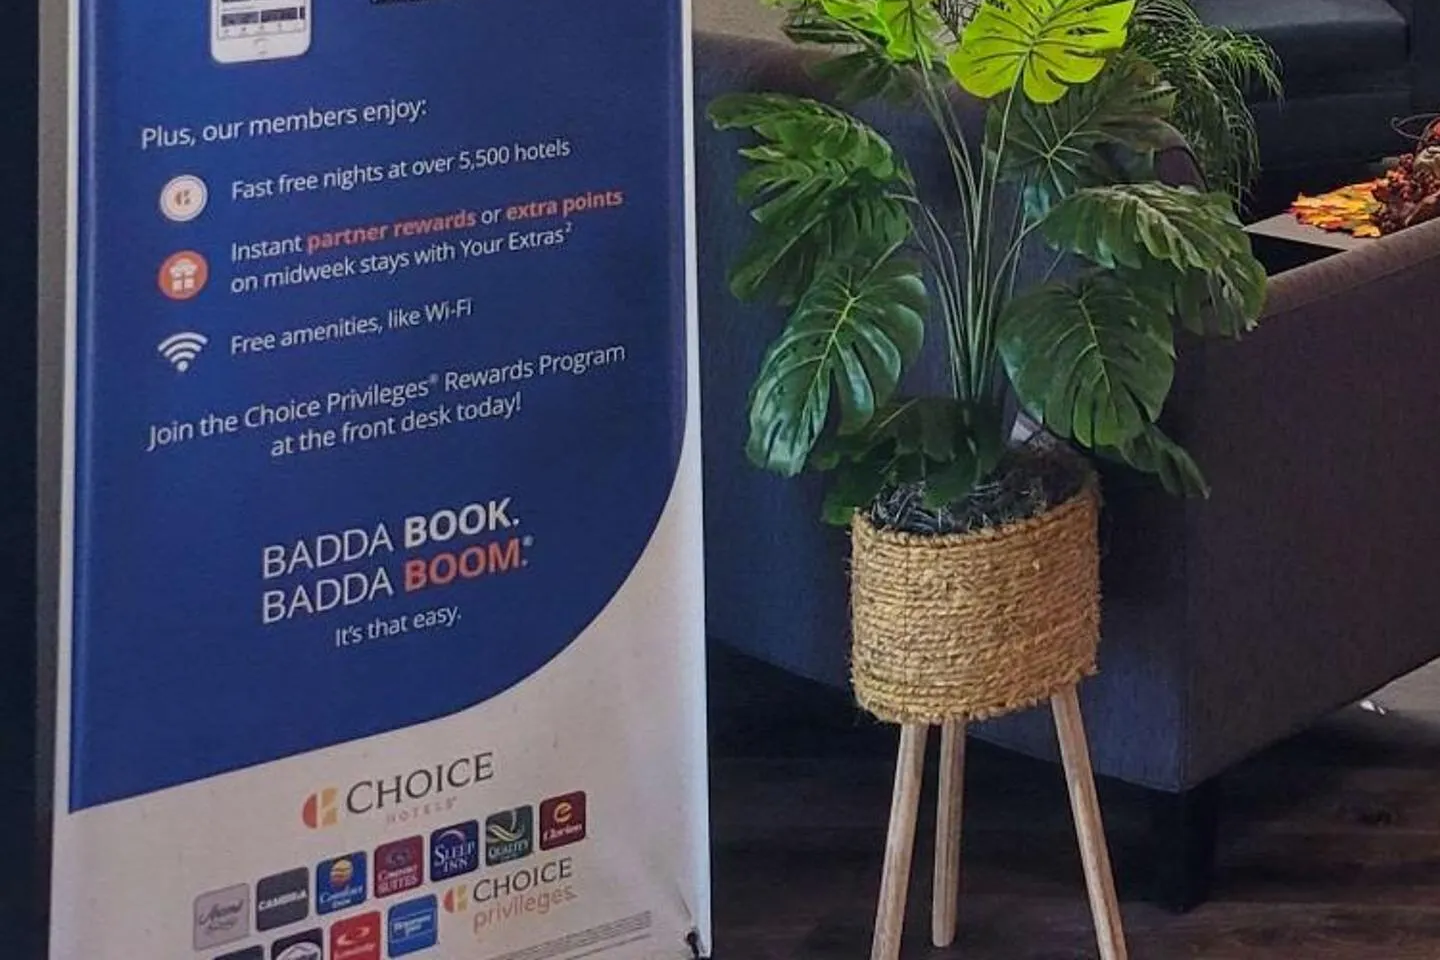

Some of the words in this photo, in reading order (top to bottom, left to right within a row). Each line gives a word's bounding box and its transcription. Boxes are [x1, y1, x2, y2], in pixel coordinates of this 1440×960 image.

[141, 125, 195, 150] Plus,
[202, 120, 245, 142] our
[250, 107, 358, 137] members
[363, 98, 428, 126] enjoy:
[232, 178, 274, 201] Fast
[278, 173, 318, 194] free
[323, 163, 383, 190] nights
[388, 161, 407, 179] at
[412, 157, 454, 176] over
[459, 145, 510, 171] 5,500
[514, 138, 571, 161] hotels
[231, 233, 303, 263] Instant
[305, 223, 389, 255] partner
[393, 209, 477, 238] rewards
[481, 208, 502, 225] or
[506, 200, 558, 222] extra
[562, 189, 623, 216] points
[231, 274, 258, 293] on
[264, 255, 355, 288] midweek
[359, 250, 410, 275] stays
[414, 241, 456, 265] with
[460, 236, 504, 258] Your
[231, 333, 276, 355] Free
[280, 315, 383, 347] amenities,
[388, 307, 421, 329] like
[424, 297, 473, 323] Wi-Fi
[146, 420, 194, 452] Join
[200, 413, 239, 437] the
[244, 398, 321, 428] Choice
[444, 358, 534, 392] Rewards
[539, 344, 626, 376] Program
[271, 436, 293, 457] at
[299, 427, 336, 451] the
[342, 416, 396, 444] front
[401, 404, 452, 432] desk
[456, 391, 522, 421] today!
[263, 522, 394, 579] BADDA
[404, 496, 520, 549] BOOK.
[263, 566, 394, 624] BADDA
[368, 614, 408, 639] that
[413, 606, 462, 631] easy.
[346, 751, 494, 815] CHOICE
[473, 857, 574, 903] CHOICE
[473, 885, 579, 935] privileges
